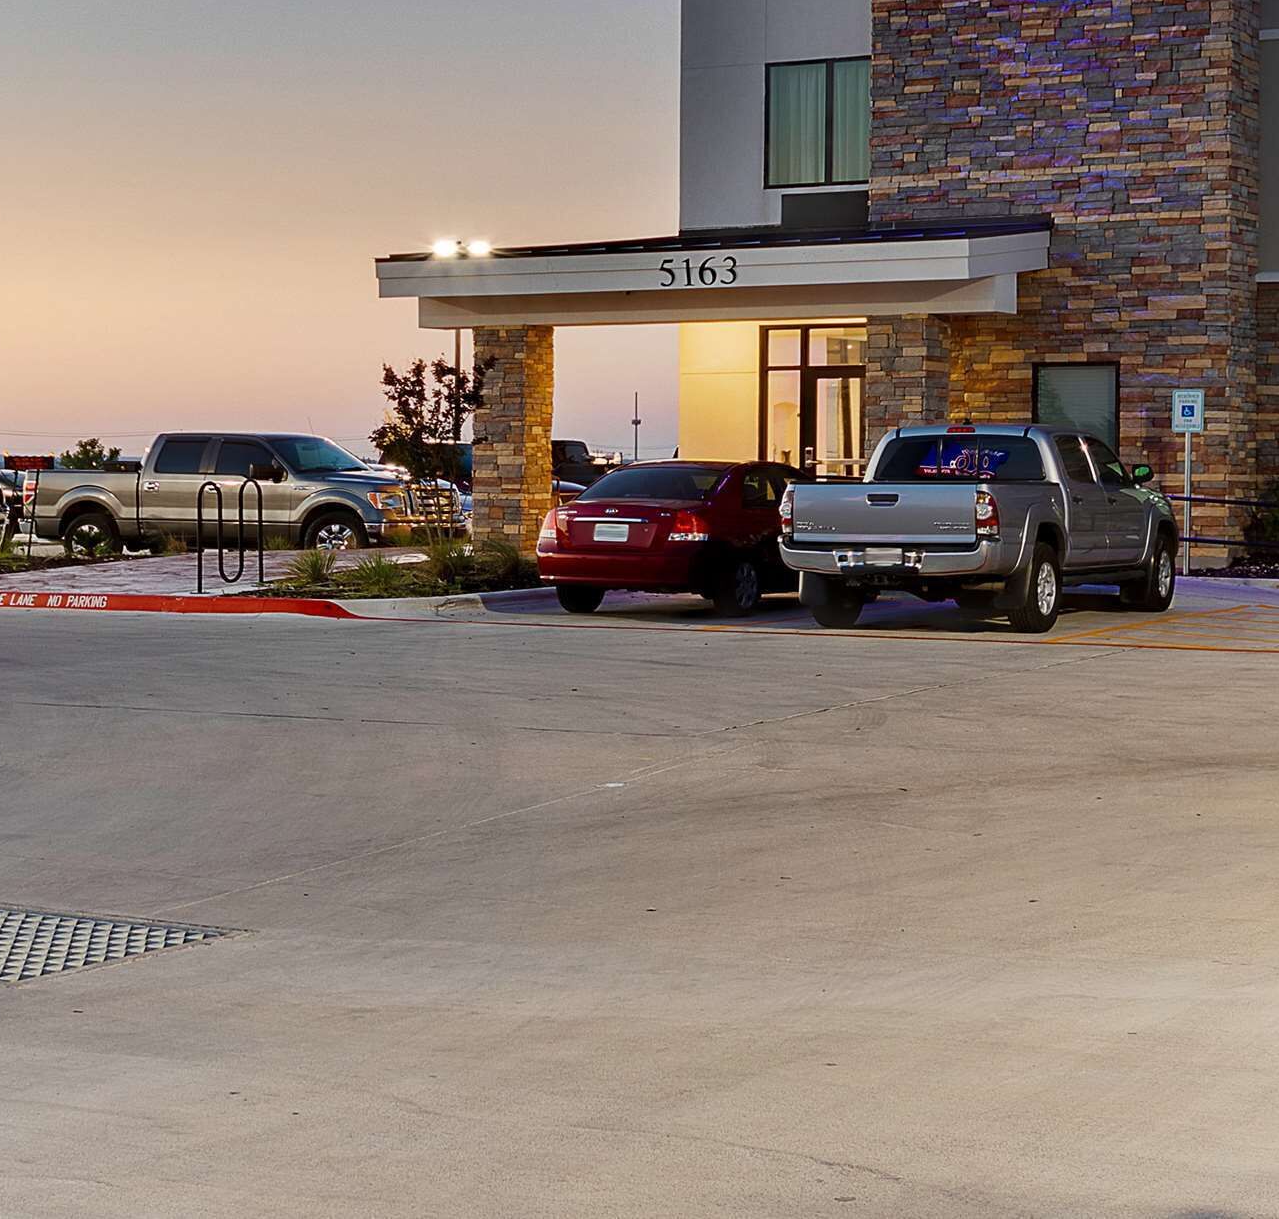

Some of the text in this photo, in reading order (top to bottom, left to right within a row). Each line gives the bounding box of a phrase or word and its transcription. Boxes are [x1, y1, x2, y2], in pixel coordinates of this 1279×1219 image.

[659, 256, 737, 287] 5163
[10, 594, 38, 606] LANE
[47, 595, 62, 607] NO
[66, 595, 108, 608] PARKING
